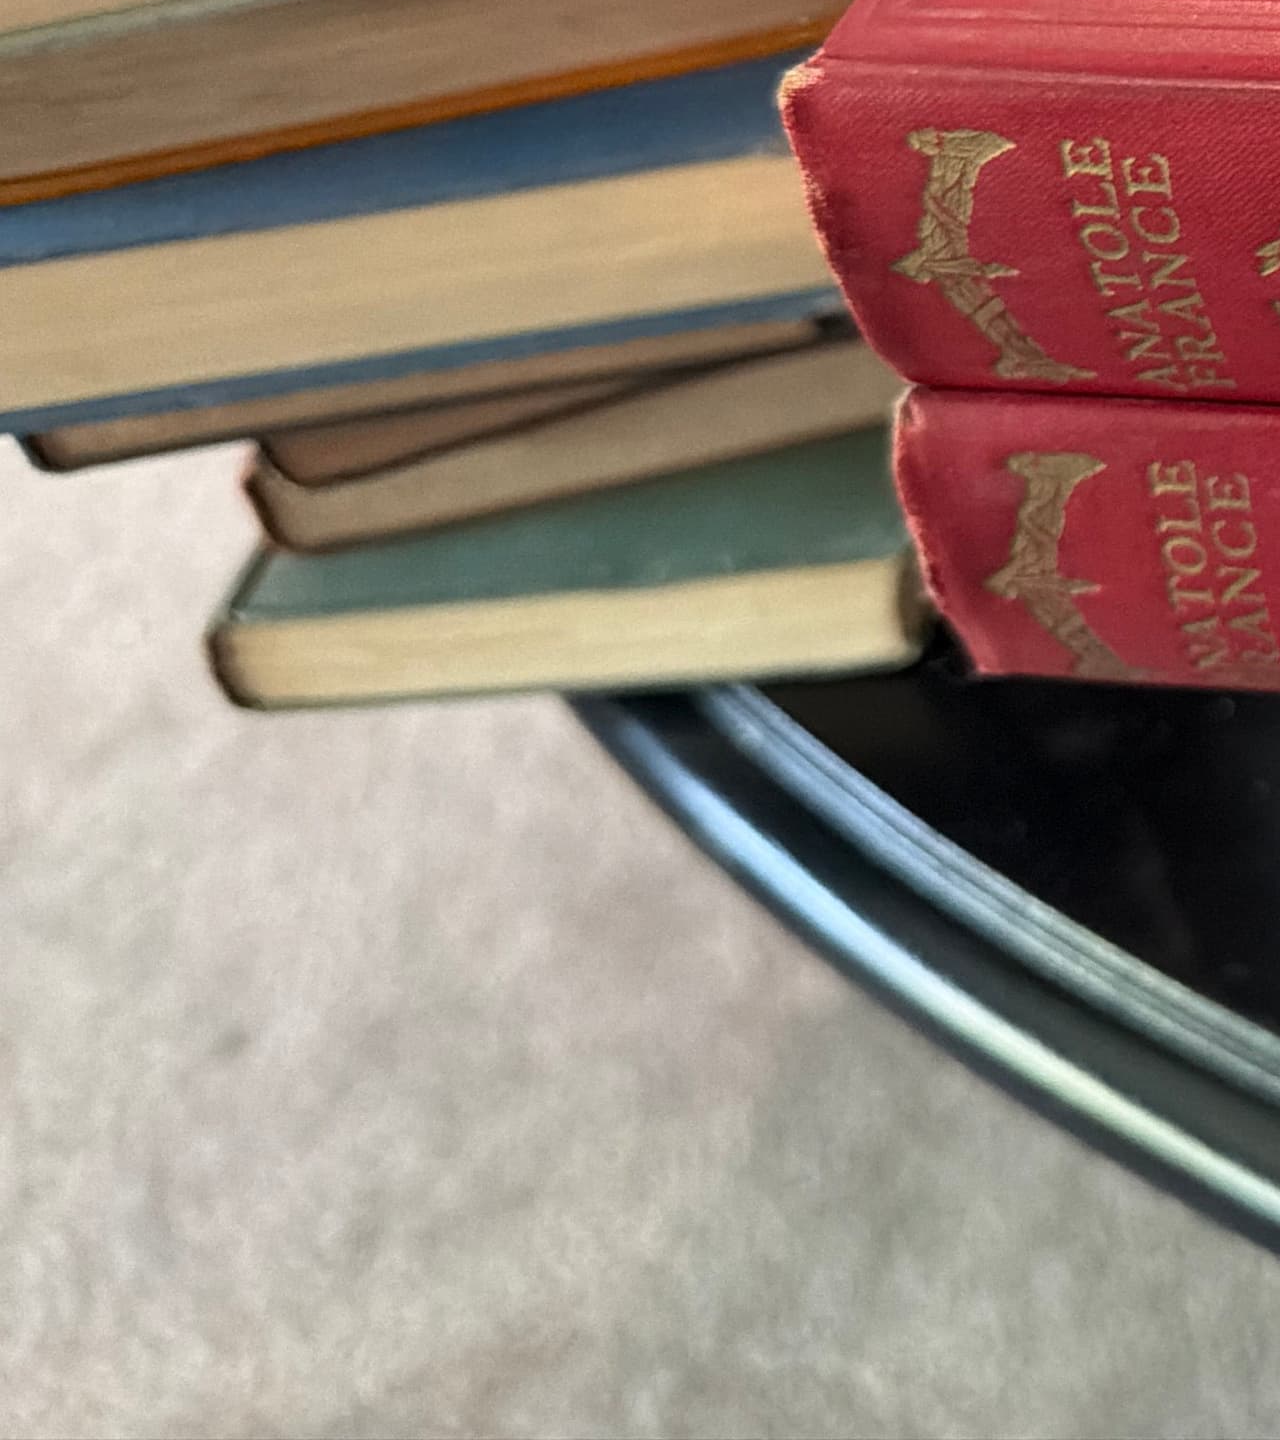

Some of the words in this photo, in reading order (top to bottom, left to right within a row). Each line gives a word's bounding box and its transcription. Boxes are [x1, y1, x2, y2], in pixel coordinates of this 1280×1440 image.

[1060, 137, 1168, 392] ANATOLE
[1121, 152, 1237, 389] FRANCE
[1147, 459, 1231, 672] NATOLE
